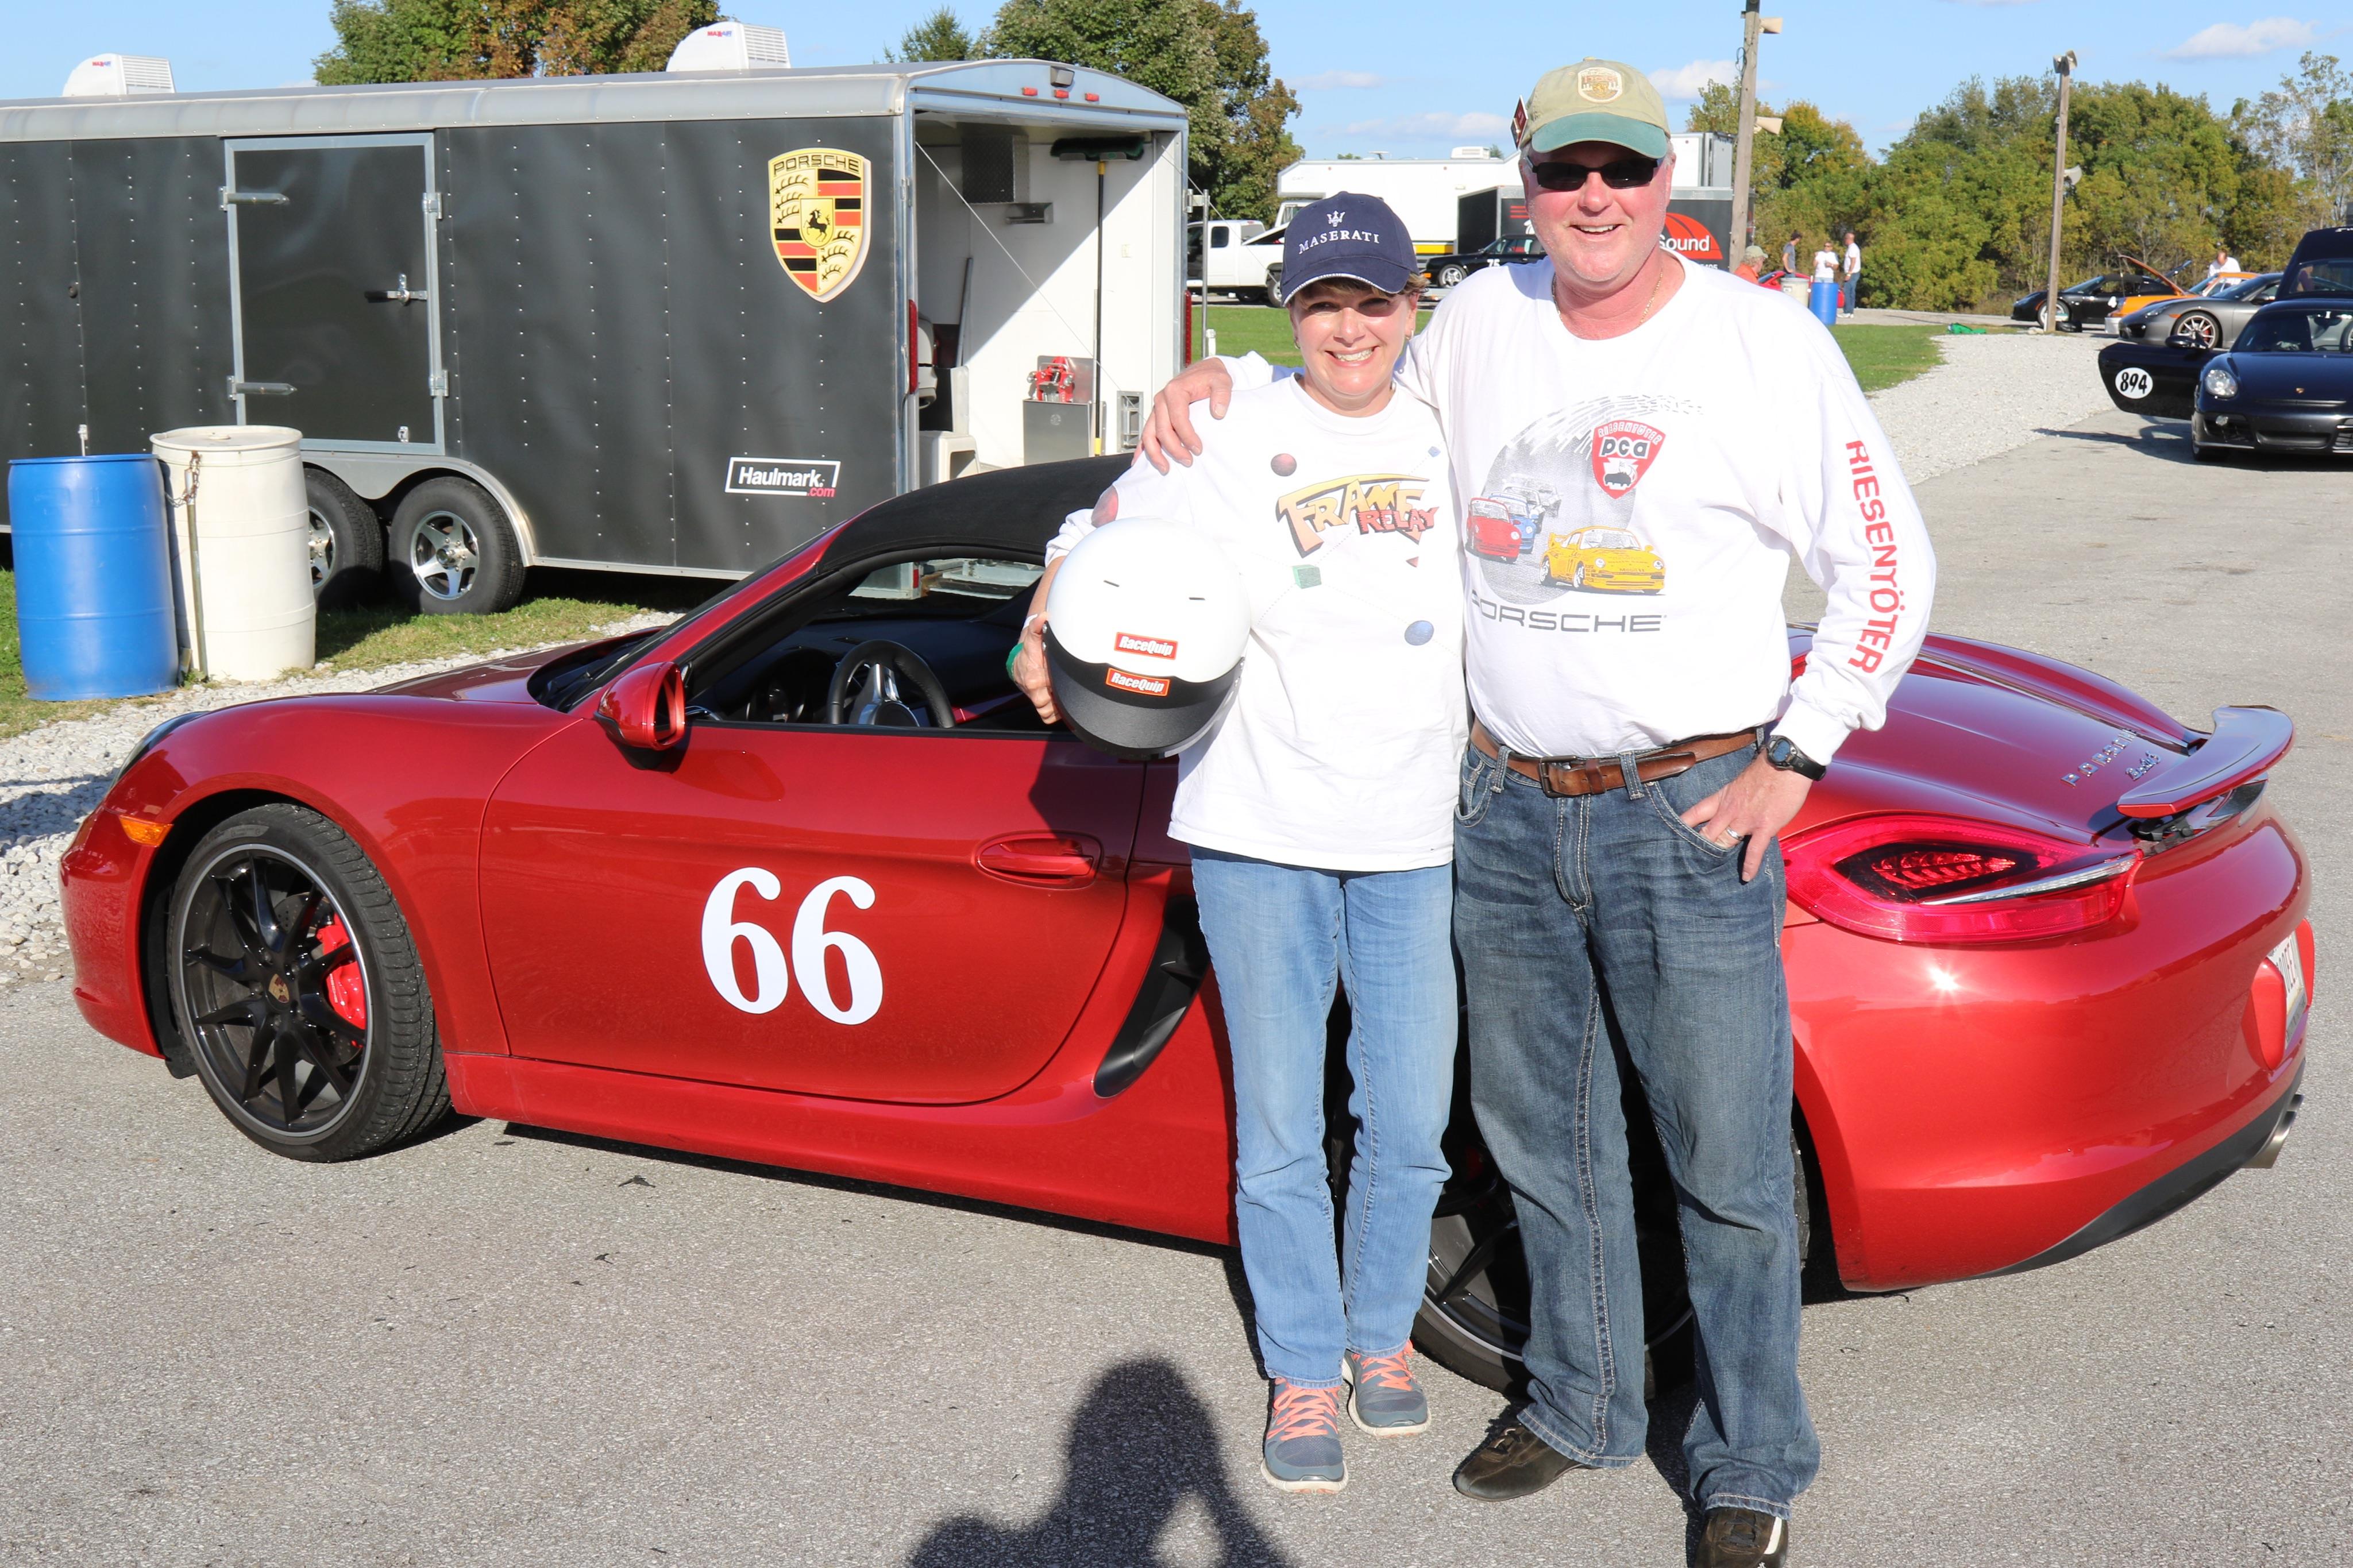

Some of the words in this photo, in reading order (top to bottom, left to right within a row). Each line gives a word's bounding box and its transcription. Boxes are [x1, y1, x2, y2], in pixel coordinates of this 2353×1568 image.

[773, 155, 860, 175] PORSCHE
[1298, 230, 1380, 254] MASERATI
[2120, 372, 2147, 395] 894
[738, 466, 821, 488] Haulmark
[1275, 473, 1430, 558] FRAME
[1356, 507, 1440, 535] RELAY
[1845, 440, 1905, 673] RIESENTÖTER
[1118, 635, 1174, 656] RaceQuip
[1110, 671, 1164, 693] RaceQuip
[701, 867, 884, 1025] 66
